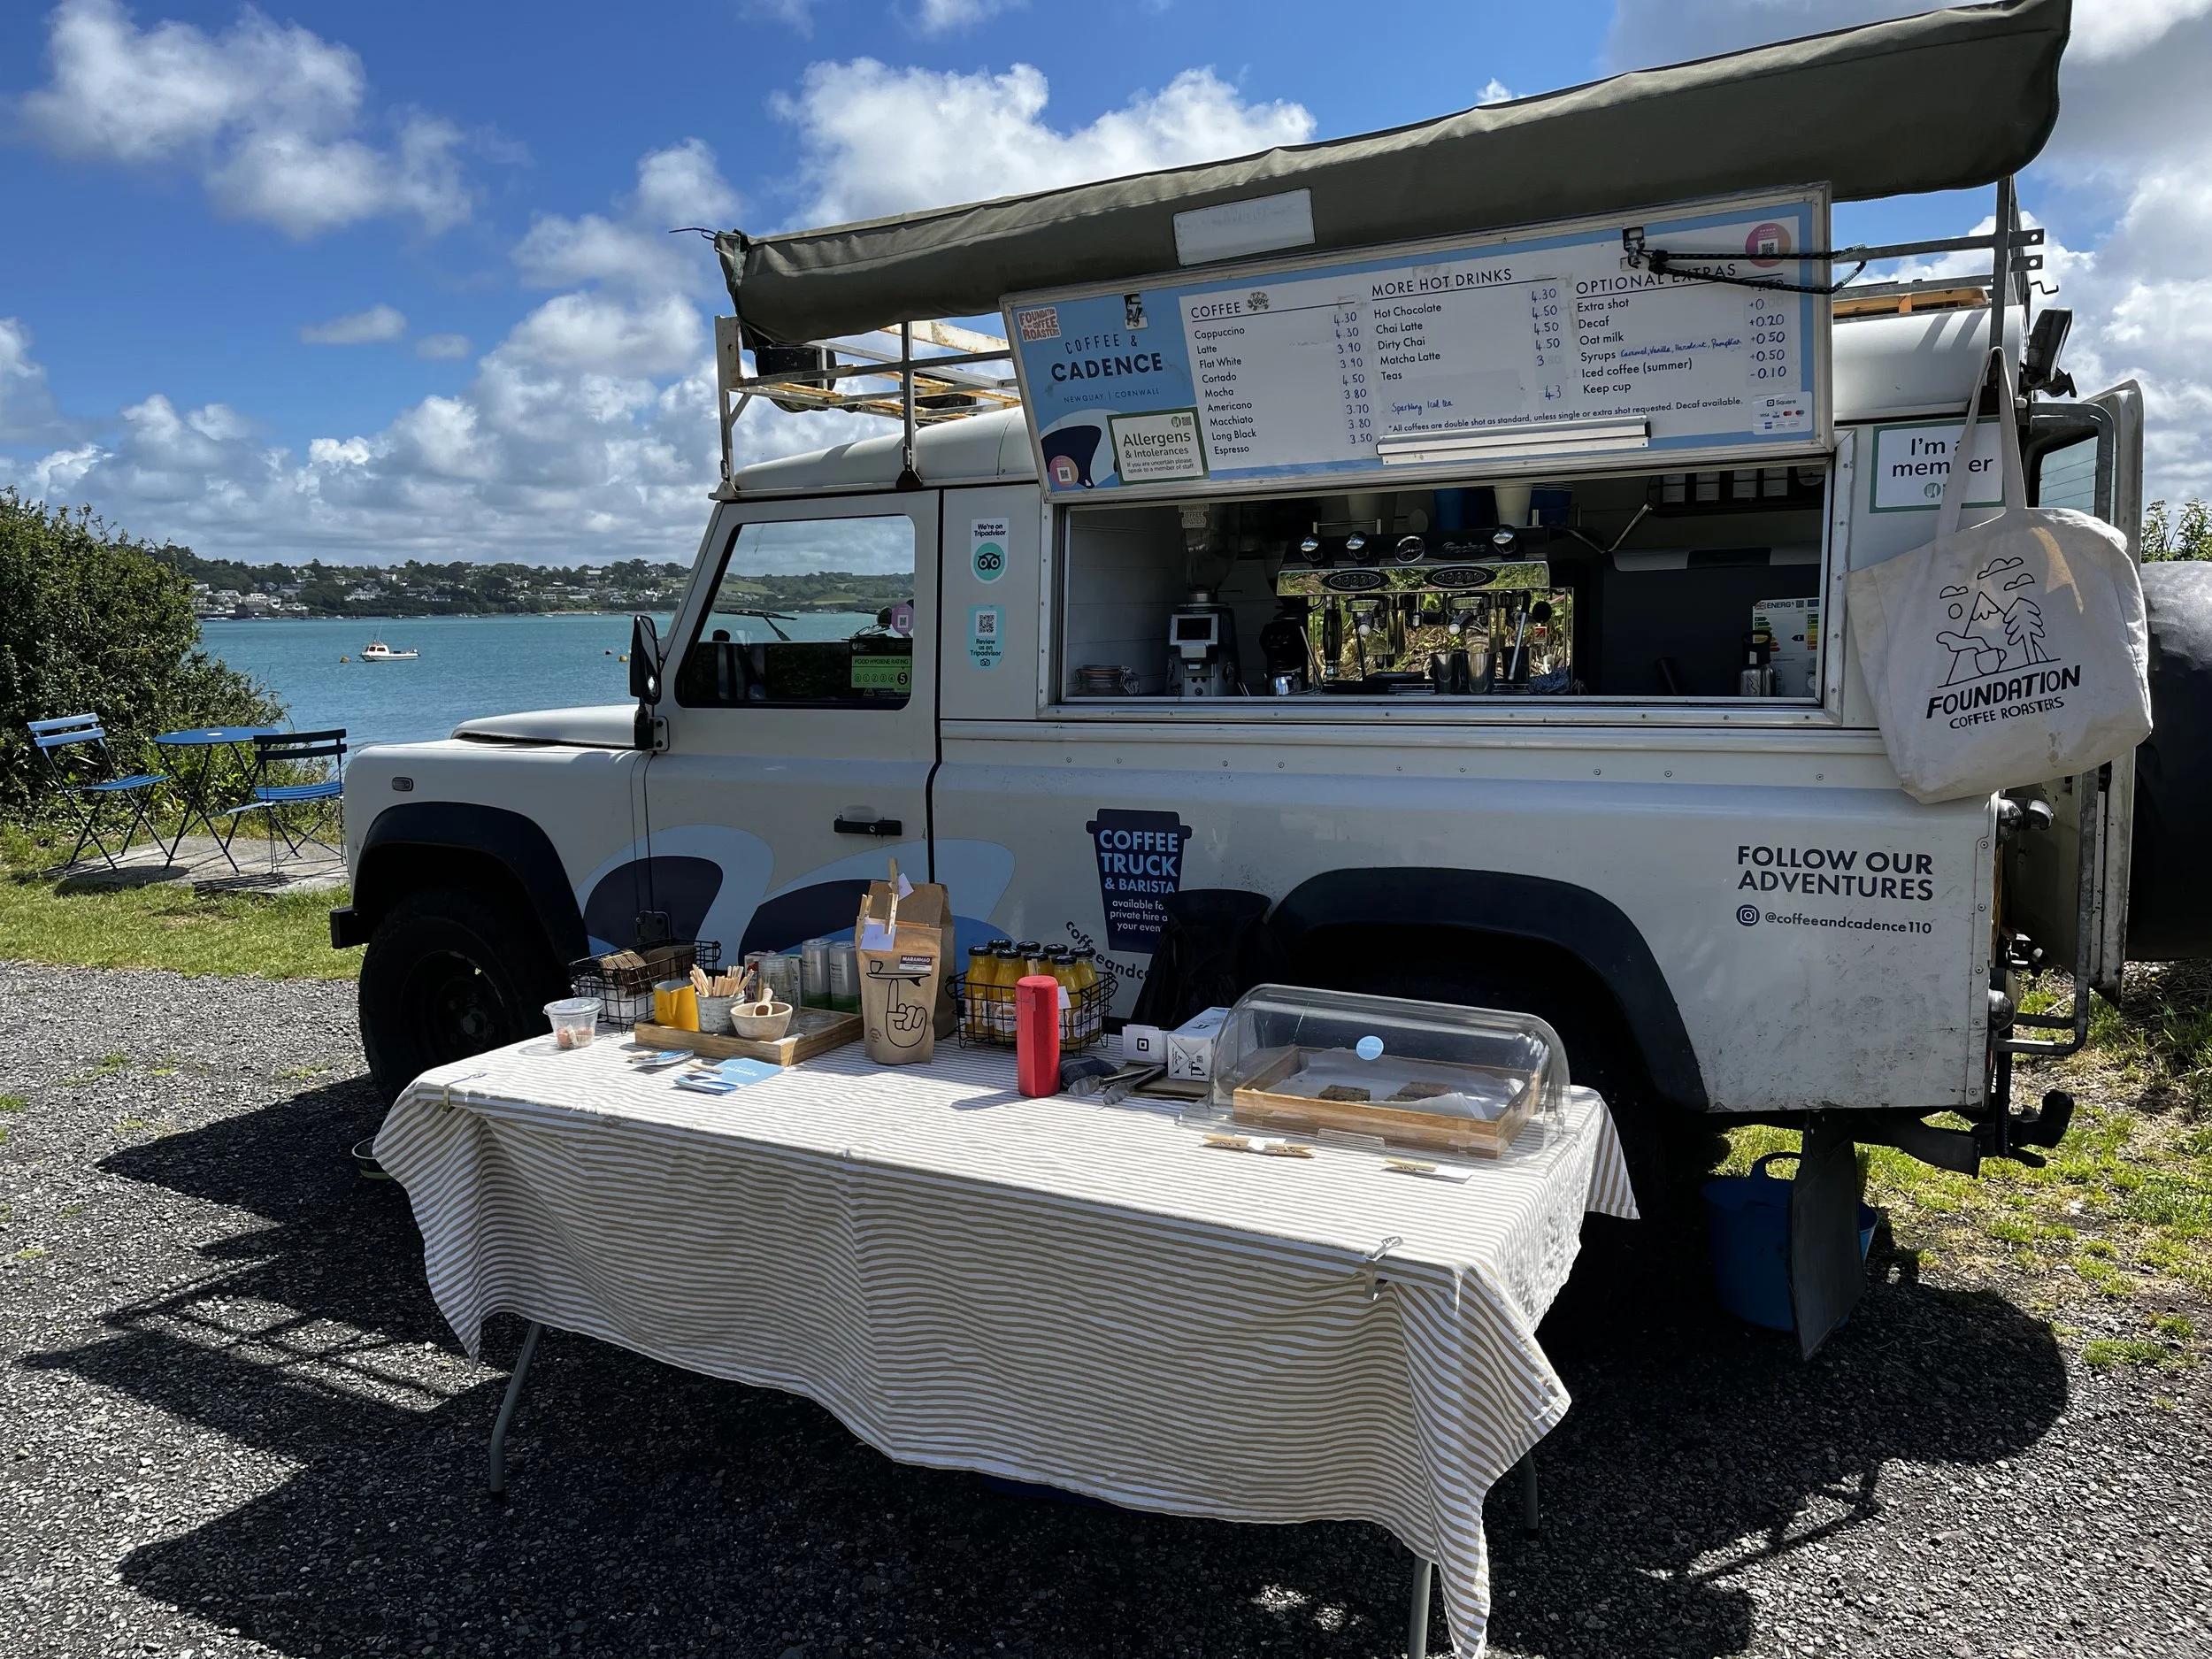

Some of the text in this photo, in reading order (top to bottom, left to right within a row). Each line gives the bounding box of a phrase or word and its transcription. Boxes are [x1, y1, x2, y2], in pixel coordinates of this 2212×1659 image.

[1371, 268, 1512, 297] MORE HOT DRINKS
[1576, 273, 1664, 296] OPTIONAL
[1532, 288, 1557, 303] 4.30
[1191, 302, 1241, 319] COFFEE
[1374, 303, 1442, 319] Hot Chocolate
[1532, 304, 1558, 320] 4.50
[1577, 297, 1630, 312] Extra shot
[1033, 315, 1057, 328] COFFEE
[1333, 311, 1357, 327] 4.30
[1578, 317, 1610, 329] Decaf
[1749, 313, 1785, 327] +0.20
[1022, 328, 1060, 341] ROASTERS
[1194, 326, 1245, 342] Cappuccino
[1335, 326, 1359, 340] 4.30
[1376, 320, 1423, 334] Chai Latte
[1533, 321, 1560, 336] 4.50
[1064, 334, 1138, 354] COFFEE &
[1378, 337, 1425, 352] Dirty Chai
[1535, 337, 1561, 352] 4.50
[1579, 331, 1624, 346] Oat milk
[1197, 344, 1217, 355] Latte
[1337, 342, 1362, 355] 3.90
[1200, 357, 1242, 369] Flat White
[1340, 357, 1363, 369] 3.90
[1380, 351, 1441, 366] Matcha Latte
[1580, 350, 1617, 365] Syrups
[1051, 352, 1163, 382] CADENCE
[1581, 358, 1693, 379] Iced coffee (summer)
[1202, 372, 1237, 384] Cortado
[1381, 371, 1402, 380] Teas
[1064, 388, 1160, 403] NEWQUAY CORNWALL
[1204, 387, 1234, 398] Mocha
[1583, 382, 1632, 396] Keep cup
[1207, 401, 1253, 412] Americano
[1346, 403, 1370, 415] 3.70
[1210, 416, 1254, 426] Macchiato
[1404, 422, 1430, 432] coffees
[1444, 418, 1470, 428] double
[1471, 418, 1486, 427] shot
[1497, 413, 1532, 425] standard,
[1533, 411, 1556, 421] unless
[1558, 410, 1580, 421] single
[1593, 408, 1614, 417] extra
[1632, 403, 1674, 414] requested.
[1676, 400, 1701, 410] Decaf
[1701, 397, 1743, 408] available.
[1348, 418, 1371, 430] 3.80
[1124, 432, 1191, 448] Allergens
[1211, 428, 1256, 442] Long Black
[1349, 432, 1373, 445] 3.50
[1125, 447, 1189, 459] & Intolerances
[1214, 445, 1250, 456] Espresso
[1910, 437, 1946, 457] I'm
[1892, 457, 1993, 477] memer
[973, 529, 1007, 538] Tripadvisor
[899, 673, 906, 684] 5
[1926, 664, 2081, 719] FOUNDATION
[1949, 696, 2065, 729] COFFEE ROASTERS
[1099, 829, 1179, 853] COFFEE
[1100, 852, 1178, 877] TRUCK
[1737, 845, 1934, 875] FOLLOW OUR
[1104, 877, 1176, 894] & BARISTA
[1737, 870, 1933, 902] ADVENTURES
[1112, 898, 1164, 910] available fo
[1110, 909, 1141, 920] private
[1142, 910, 1160, 921] hire
[1765, 911, 1932, 934] @coffeeandcadence110
[1117, 922, 1138, 932] your
